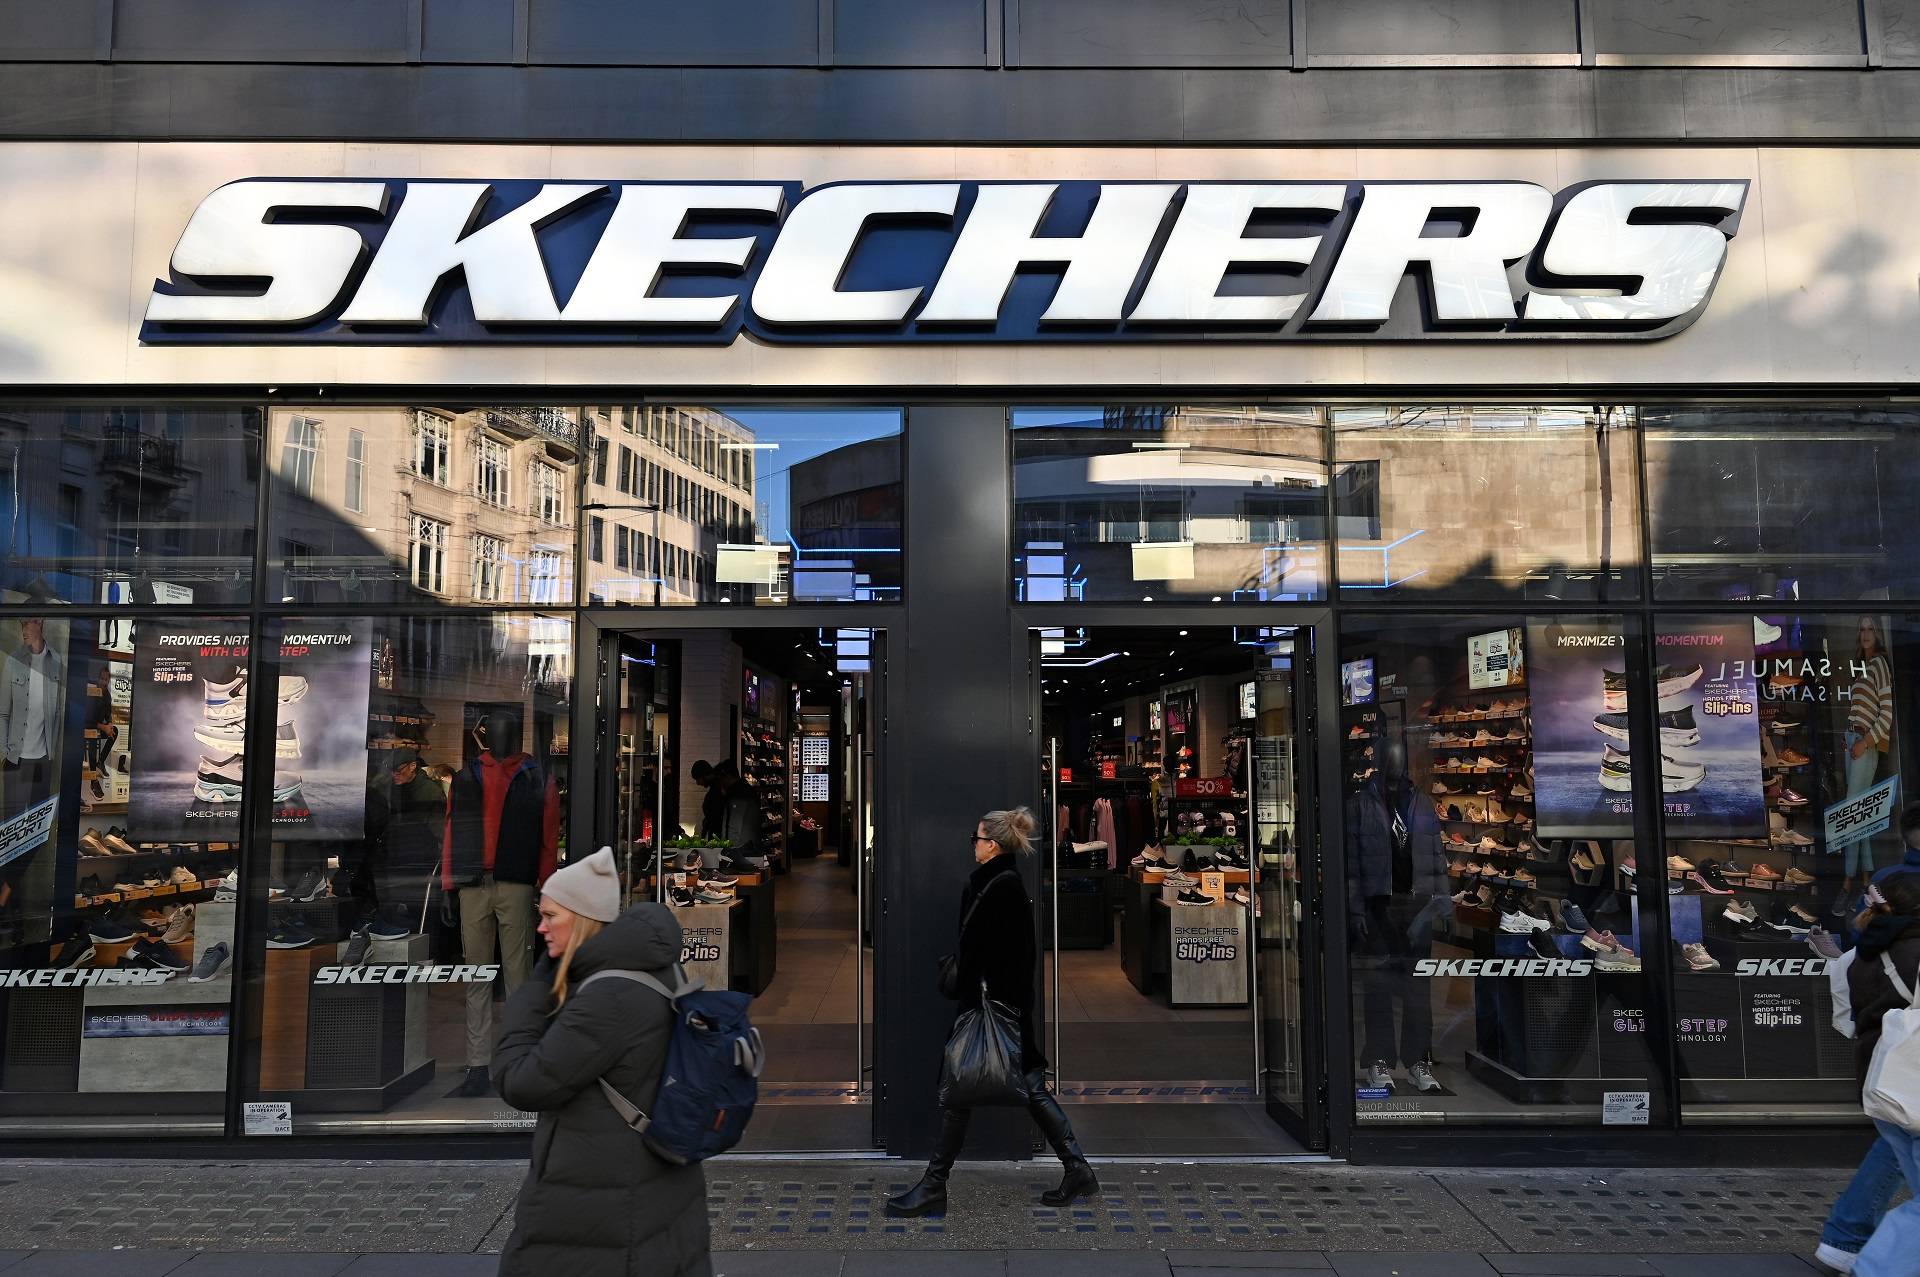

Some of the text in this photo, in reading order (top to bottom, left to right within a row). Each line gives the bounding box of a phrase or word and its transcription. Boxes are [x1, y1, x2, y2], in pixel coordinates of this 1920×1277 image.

[144, 179, 1748, 336] SKECHERS
[159, 635, 221, 646] PROVIDES
[283, 634, 352, 645] MOMENTUM
[1557, 635, 1616, 647] MAXIMIZE
[1655, 635, 1724, 646] MOMENTUM
[200, 646, 230, 657] WITH
[153, 671, 193, 684] Slip-ins
[1704, 701, 1752, 716] Slip-ins
[1362, 712, 1377, 722] RUN
[1196, 780, 1224, 794] 50%
[1827, 786, 1890, 825] SKECHERS
[185, 810, 239, 818] SKECHERS
[1834, 801, 1884, 833] SPORT
[1174, 927, 1239, 936] SKECHERS
[1177, 943, 1236, 962] Slip-ins
[313, 964, 501, 984] SKECHERS
[1412, 958, 1595, 977] SKECHERS
[91, 1015, 148, 1023] SKECHERS
[1754, 1012, 1802, 1028] Slip-ins
[1357, 1102, 1421, 1112] SHOP ONLINE
[493, 1111, 519, 1120] SHOP
